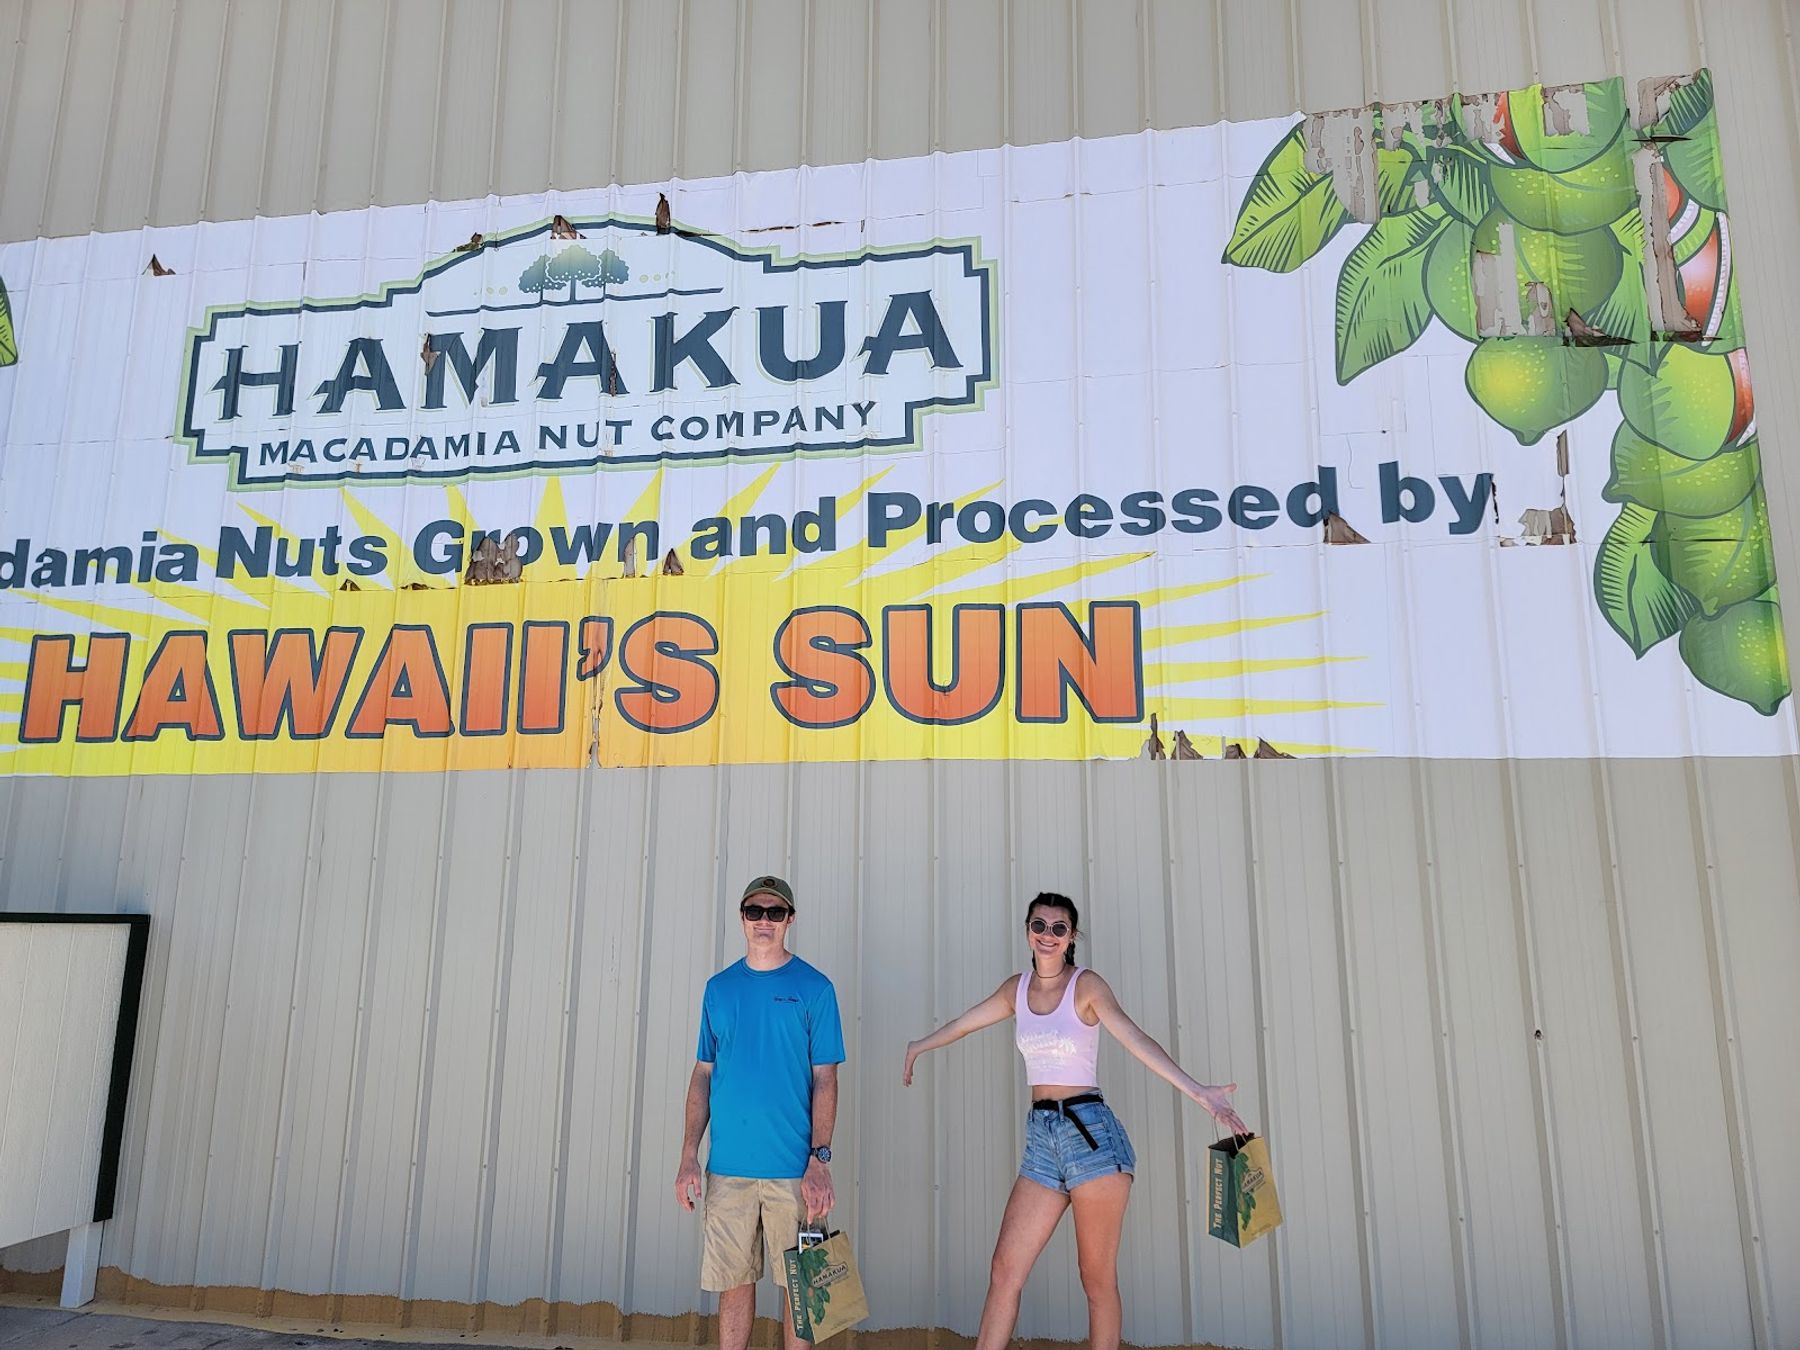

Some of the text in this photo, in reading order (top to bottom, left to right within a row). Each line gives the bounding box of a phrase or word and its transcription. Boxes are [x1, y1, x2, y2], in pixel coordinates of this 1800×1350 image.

[208, 289, 965, 420] HAMAKUA
[259, 401, 877, 466] MACADAMIA NUT COMPANY
[216, 525, 389, 579] Nuts
[690, 495, 837, 561] and
[867, 464, 1338, 549] Processed
[1378, 460, 1494, 535] by
[770, 600, 1145, 730] SUN
[789, 1259, 798, 1276] NUT
[813, 1265, 846, 1284] HAMAKUA
[796, 1314, 804, 1330] THE
